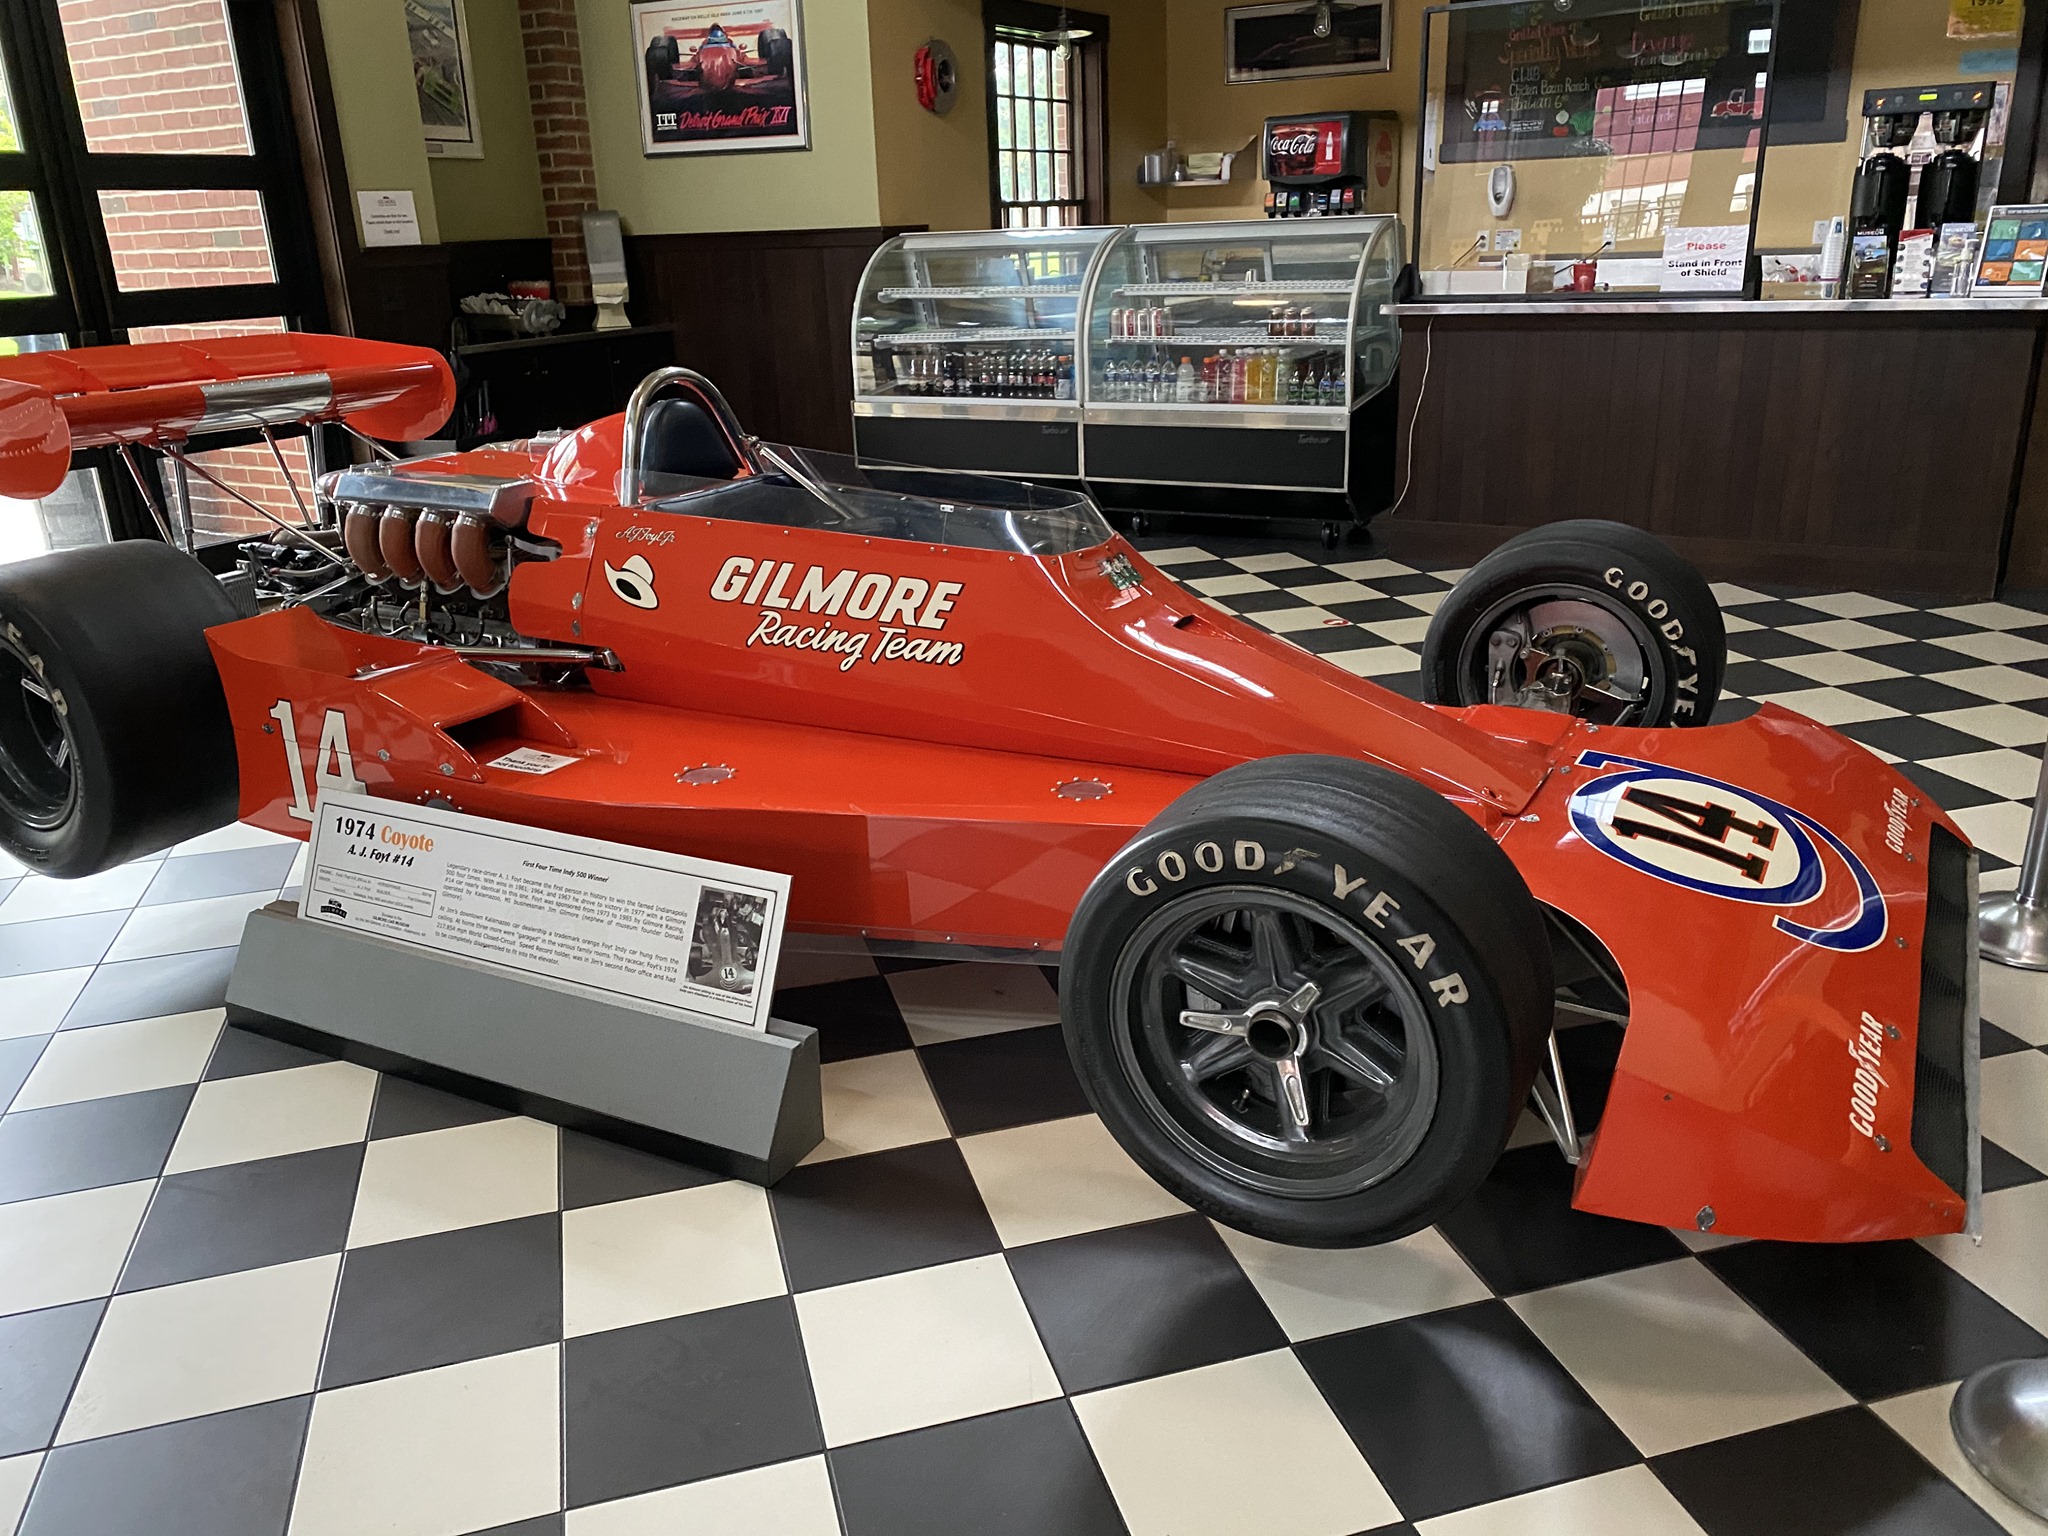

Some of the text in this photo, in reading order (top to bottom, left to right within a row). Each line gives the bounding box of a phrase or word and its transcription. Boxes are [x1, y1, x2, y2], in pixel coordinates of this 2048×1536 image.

[656, 113, 677, 126] ITT
[1270, 133, 1318, 155] Coca-Cola
[1668, 258, 1742, 268] Stand in Front
[1680, 268, 1727, 277] of Shield
[1686, 242, 1727, 251] Please
[710, 555, 966, 630] GILMORE
[746, 610, 965, 672] Racing Team
[269, 698, 368, 823] 14
[335, 816, 433, 852] 1974 Coyote
[1611, 786, 1779, 885] 14
[1884, 787, 1910, 854] GOODYEAR
[346, 843, 414, 867] A. J. Foyt #14
[522, 860, 608, 882] First Four Time Indy 500 Winner
[442, 884, 463, 893] operated
[513, 899, 545, 910] businessman
[558, 908, 579, 918] Gilmore
[615, 921, 638, 931] museum
[640, 926, 661, 936] founder
[664, 931, 683, 941] Donald
[445, 868, 455, 876] 500
[455, 870, 466, 878] four
[580, 898, 595, 906] drove
[604, 903, 622, 912] victory
[630, 908, 645, 916] 1977
[664, 915, 686, 925] Gilmore
[446, 862, 471, 873] Legendary
[471, 868, 498, 877] race-driver
[510, 874, 522, 883] Foyt
[522, 878, 542, 887] became
[552, 883, 563, 891] first
[564, 887, 582, 895] person
[589, 891, 607, 901] history
[626, 899, 636, 907] the
[636, 901, 654, 910] famed
[654, 904, 687, 917] Indianapolis
[464, 881, 479, 889] nearly
[480, 884, 501, 893] identical
[531, 894, 542, 902] Foyt
[555, 900, 581, 911] sponsored
[582, 905, 595, 914] from
[596, 909, 610, 917] 1973
[642, 918, 663, 928] Gilmore
[664, 923, 684, 934] Racing,
[459, 910, 483, 920] downtown
[484, 915, 510, 926] Kalamazoo
[521, 924, 547, 935] dealership
[553, 931, 580, 942] trademark
[581, 938, 600, 947] orange
[600, 941, 613, 950] Foyt
[614, 944, 627, 954] Indy
[639, 950, 653, 960] hung
[654, 953, 668, 962] from
[669, 957, 679, 965] the
[461, 919, 475, 927] home
[475, 922, 488, 930] three
[488, 926, 502, 934] more
[556, 942, 575, 950] various
[576, 945, 592, 954] family
[612, 953, 624, 962] This
[646, 961, 662, 970] Foyt's
[663, 965, 677, 973] 1974
[724, 968, 734, 979] 14
[1849, 1010, 1886, 1138] GOODYEAR
